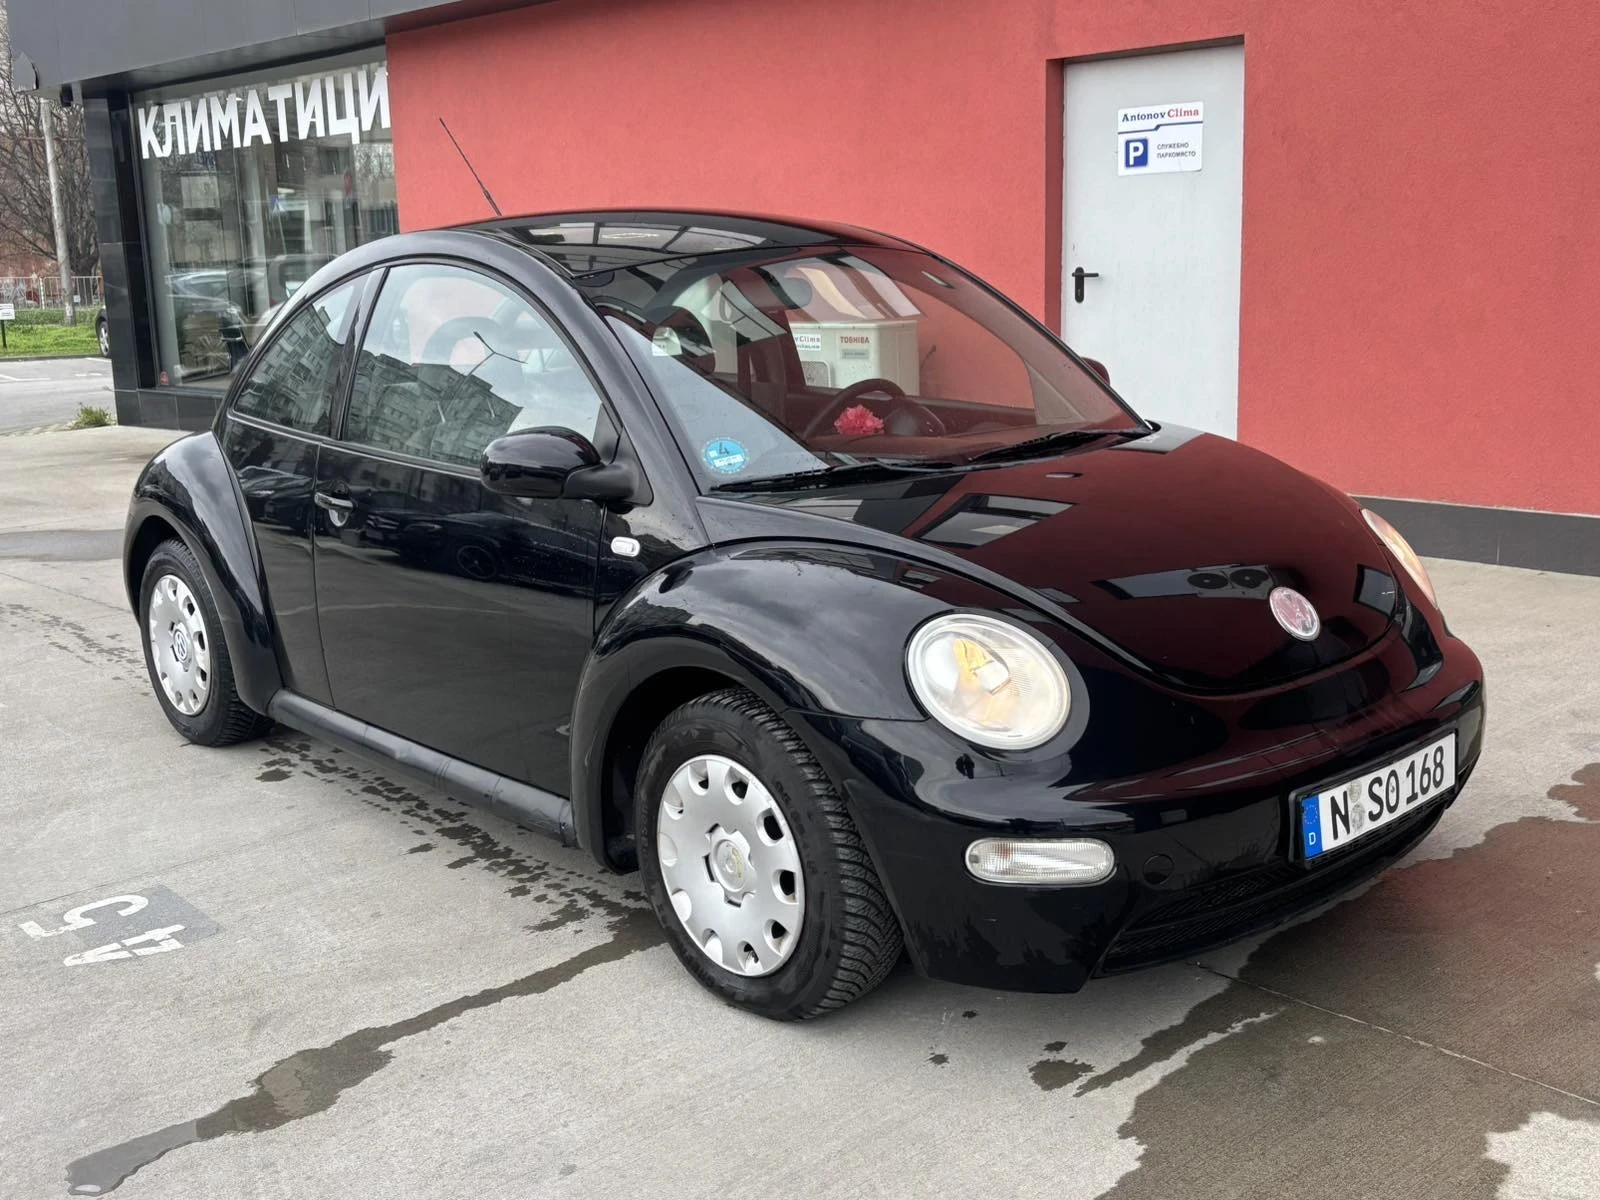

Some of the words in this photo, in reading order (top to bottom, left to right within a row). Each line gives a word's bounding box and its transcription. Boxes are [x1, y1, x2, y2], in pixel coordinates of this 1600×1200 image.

[138, 67, 391, 160] КЛИМАТИЦИ
[840, 336, 870, 344] TOSHIBA
[1330, 790, 1350, 841] N
[1406, 745, 1445, 805] 168
[1309, 832, 1317, 846] D
